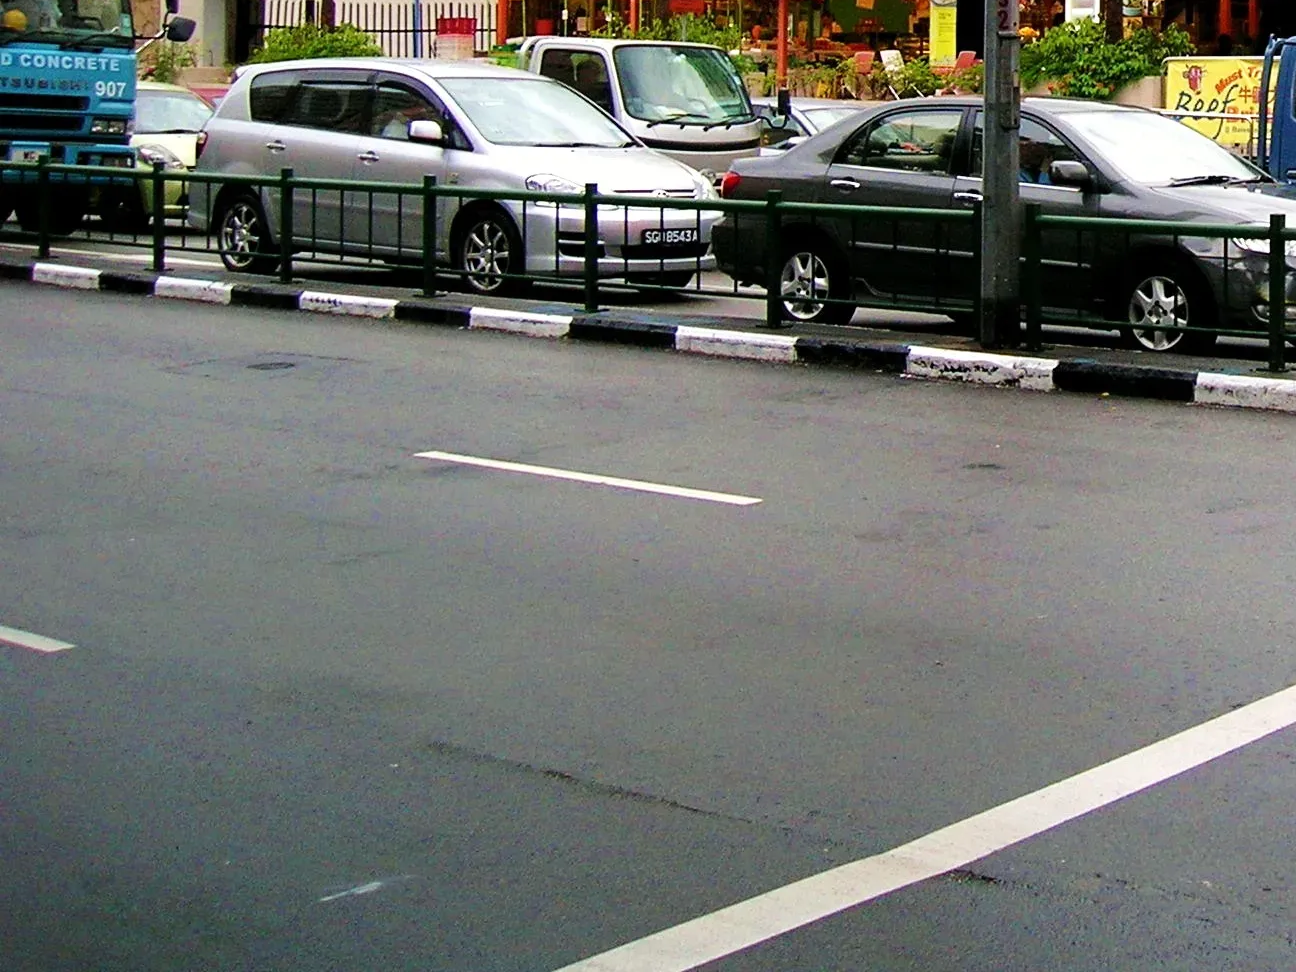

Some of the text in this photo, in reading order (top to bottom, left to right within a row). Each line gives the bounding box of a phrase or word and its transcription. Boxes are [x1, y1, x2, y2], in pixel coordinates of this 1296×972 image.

[20, 54, 120, 72] CONCRETE
[95, 81, 126, 97] 907
[1215, 68, 1244, 95] Must
